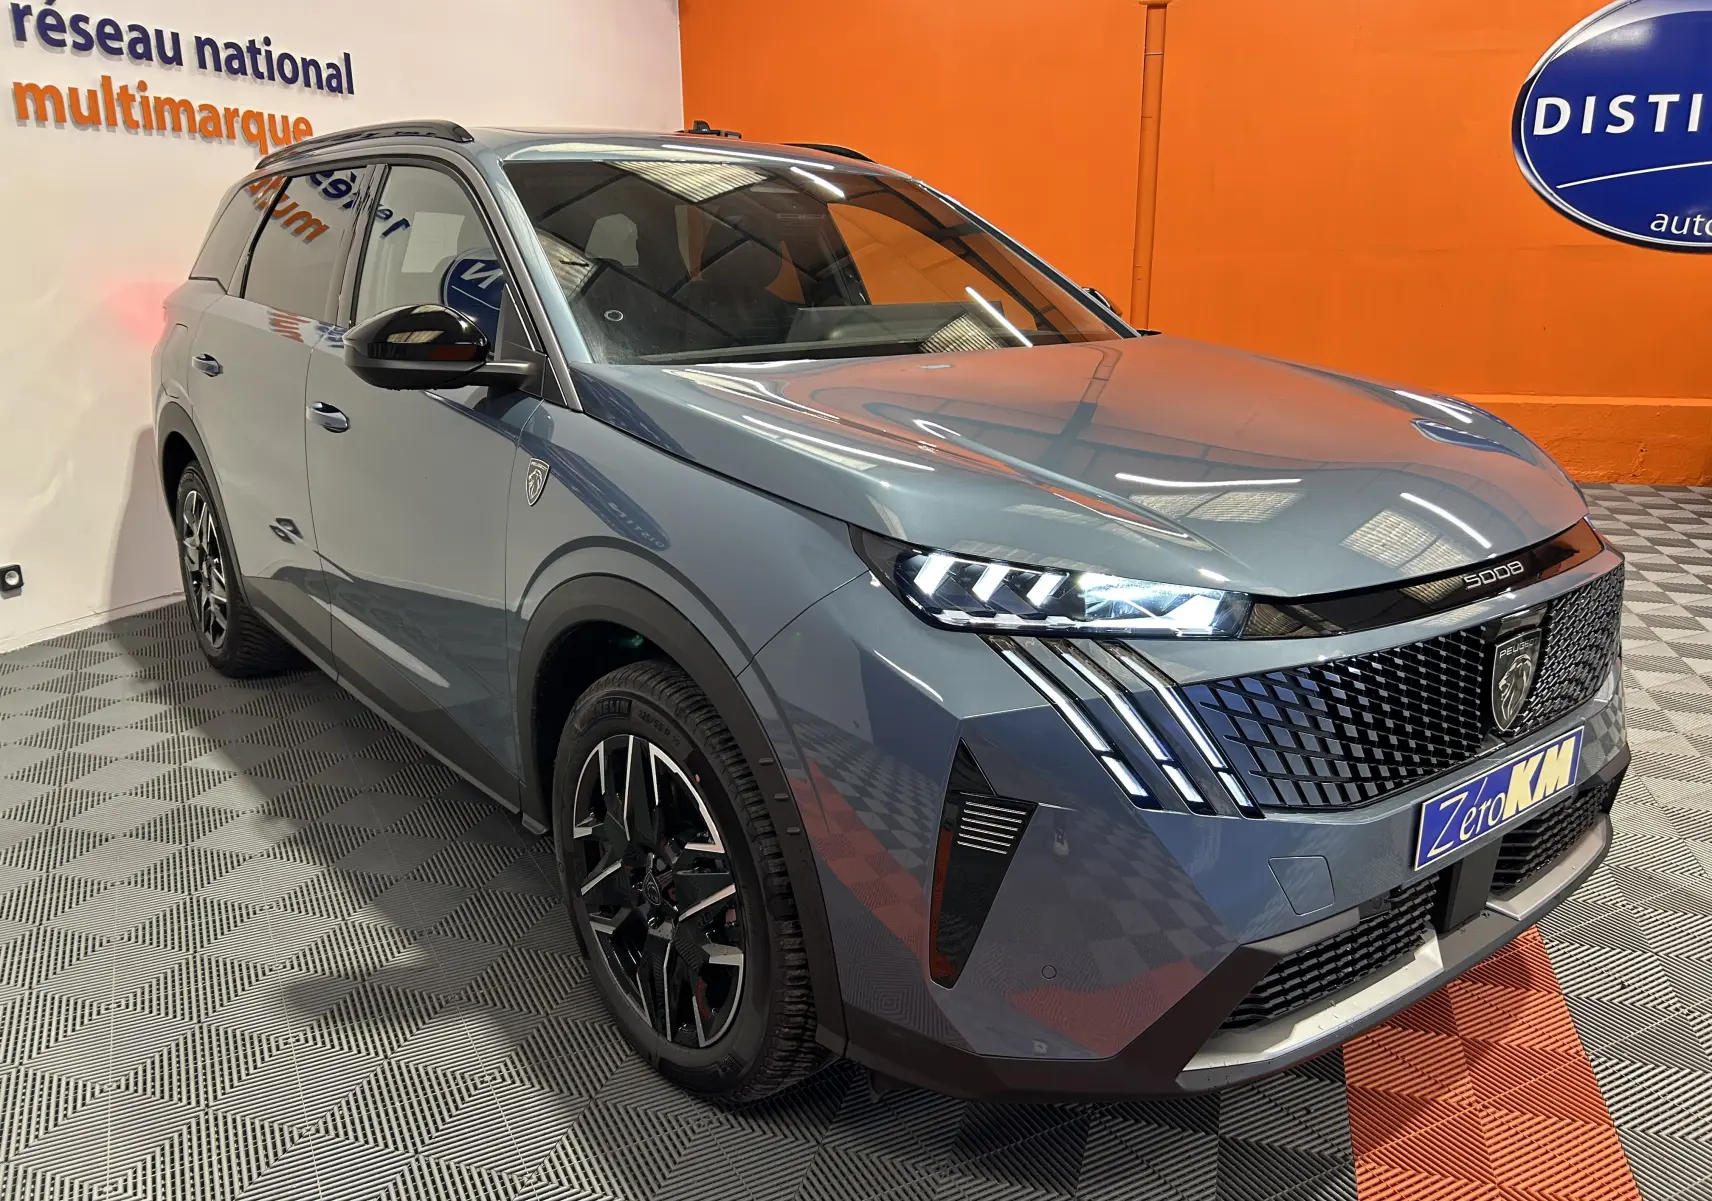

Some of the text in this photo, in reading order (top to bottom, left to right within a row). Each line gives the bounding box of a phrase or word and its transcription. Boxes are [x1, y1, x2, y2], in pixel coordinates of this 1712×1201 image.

[10, 0, 355, 95] réseau national
[13, 75, 313, 155] multimarque
[1464, 561, 1524, 590] 5008
[1499, 637, 1539, 659] PEUGEOT
